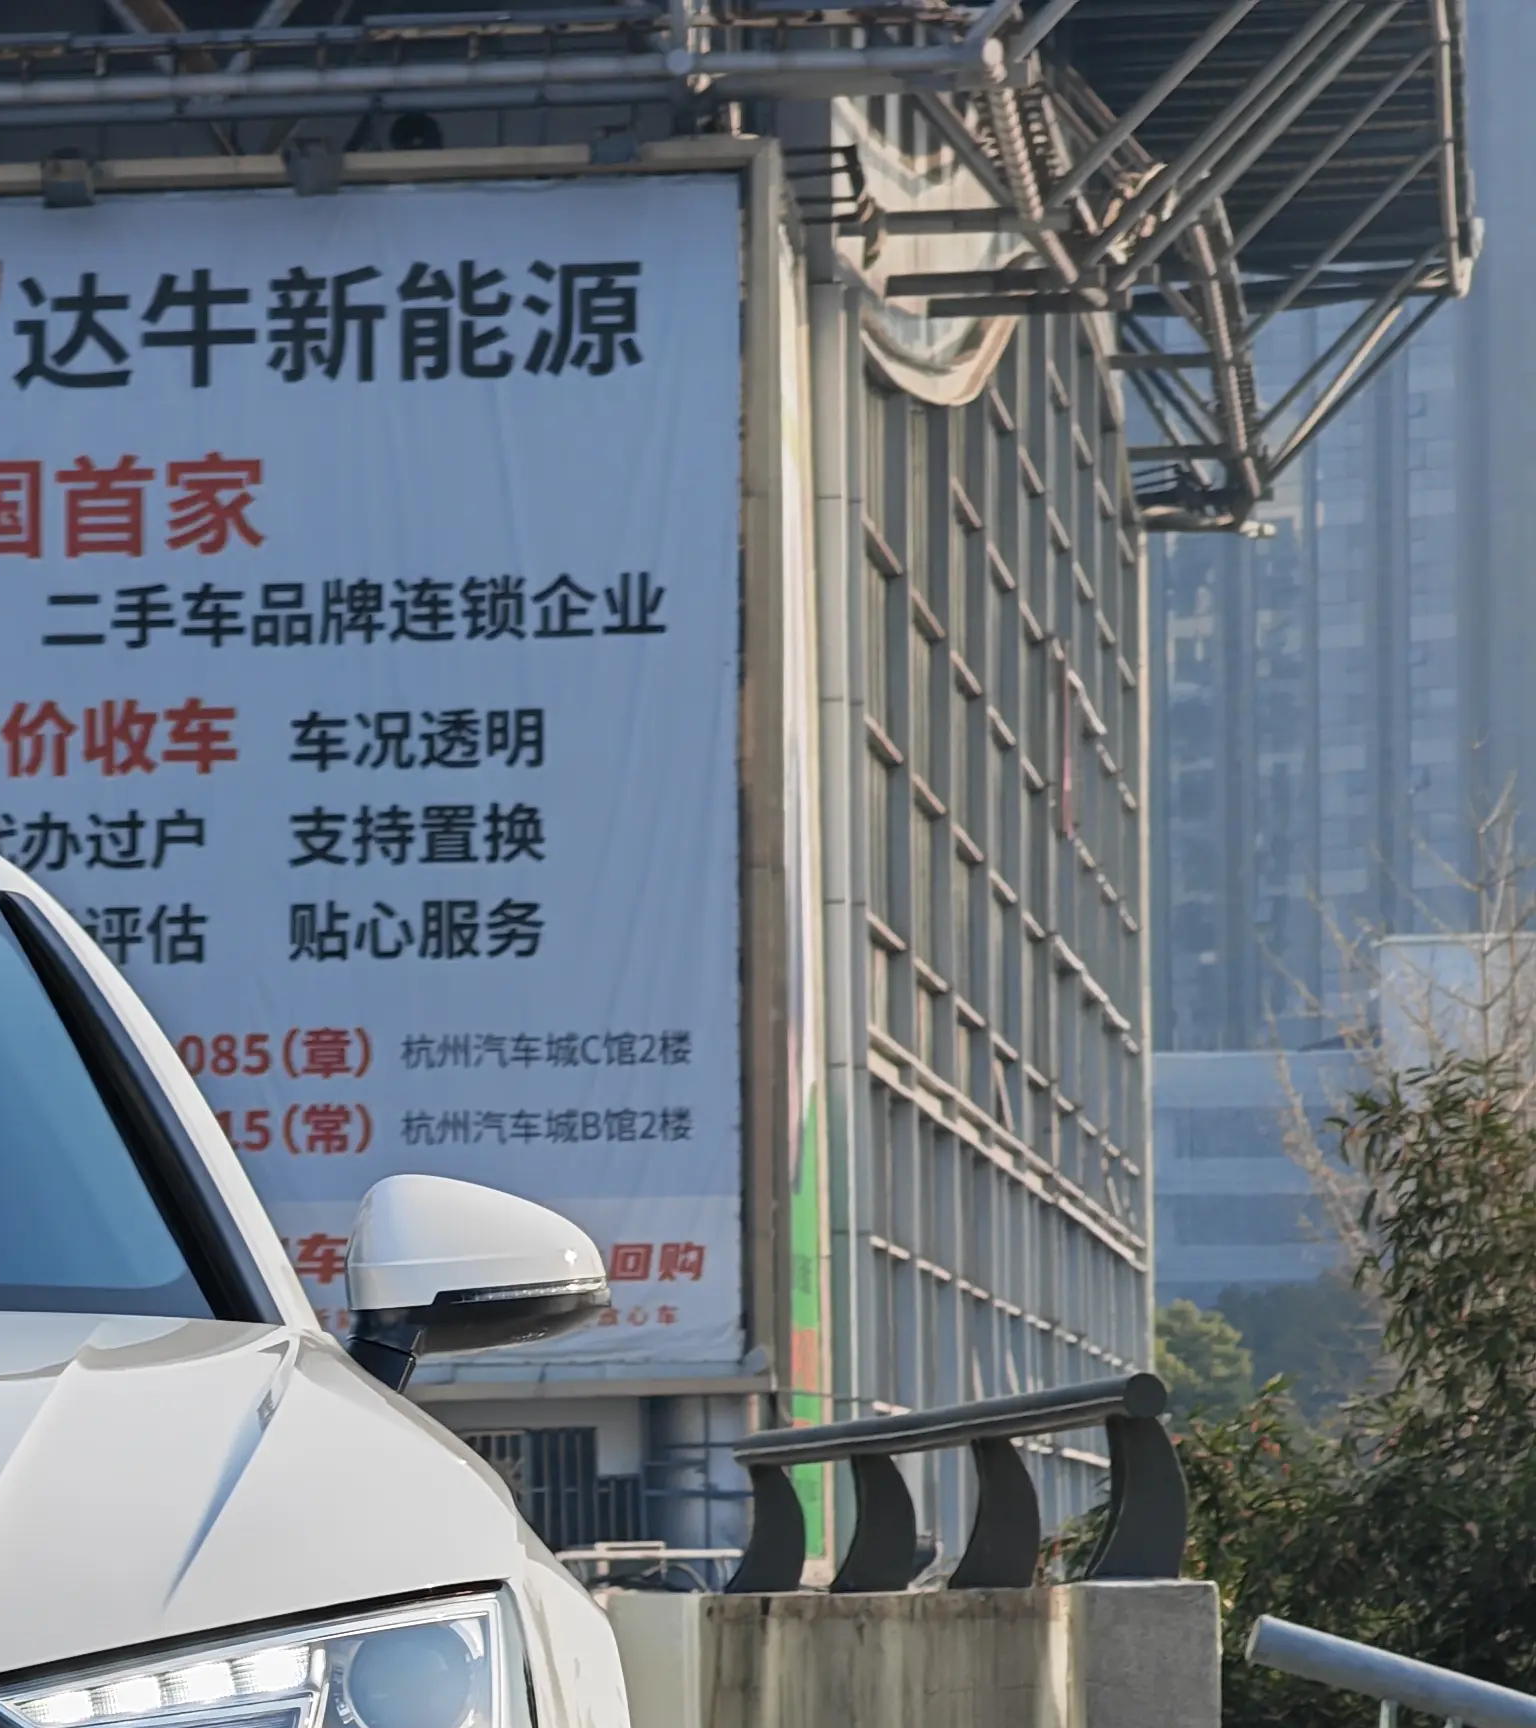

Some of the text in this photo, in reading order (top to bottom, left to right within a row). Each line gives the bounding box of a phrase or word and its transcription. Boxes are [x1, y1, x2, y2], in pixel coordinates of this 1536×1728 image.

[12, 259, 645, 390] 达牛新能源
[41, 573, 668, 650] 二手车品牌连锁企业
[289, 708, 546, 773] 车况透明
[288, 802, 546, 868] 支持置换
[69, 897, 546, 965] 评估 贴心服务
[400, 1030, 692, 1070] 杭州汽车城C馆2楼
[400, 1107, 693, 1147] 杭州汽车城B馆2楼
